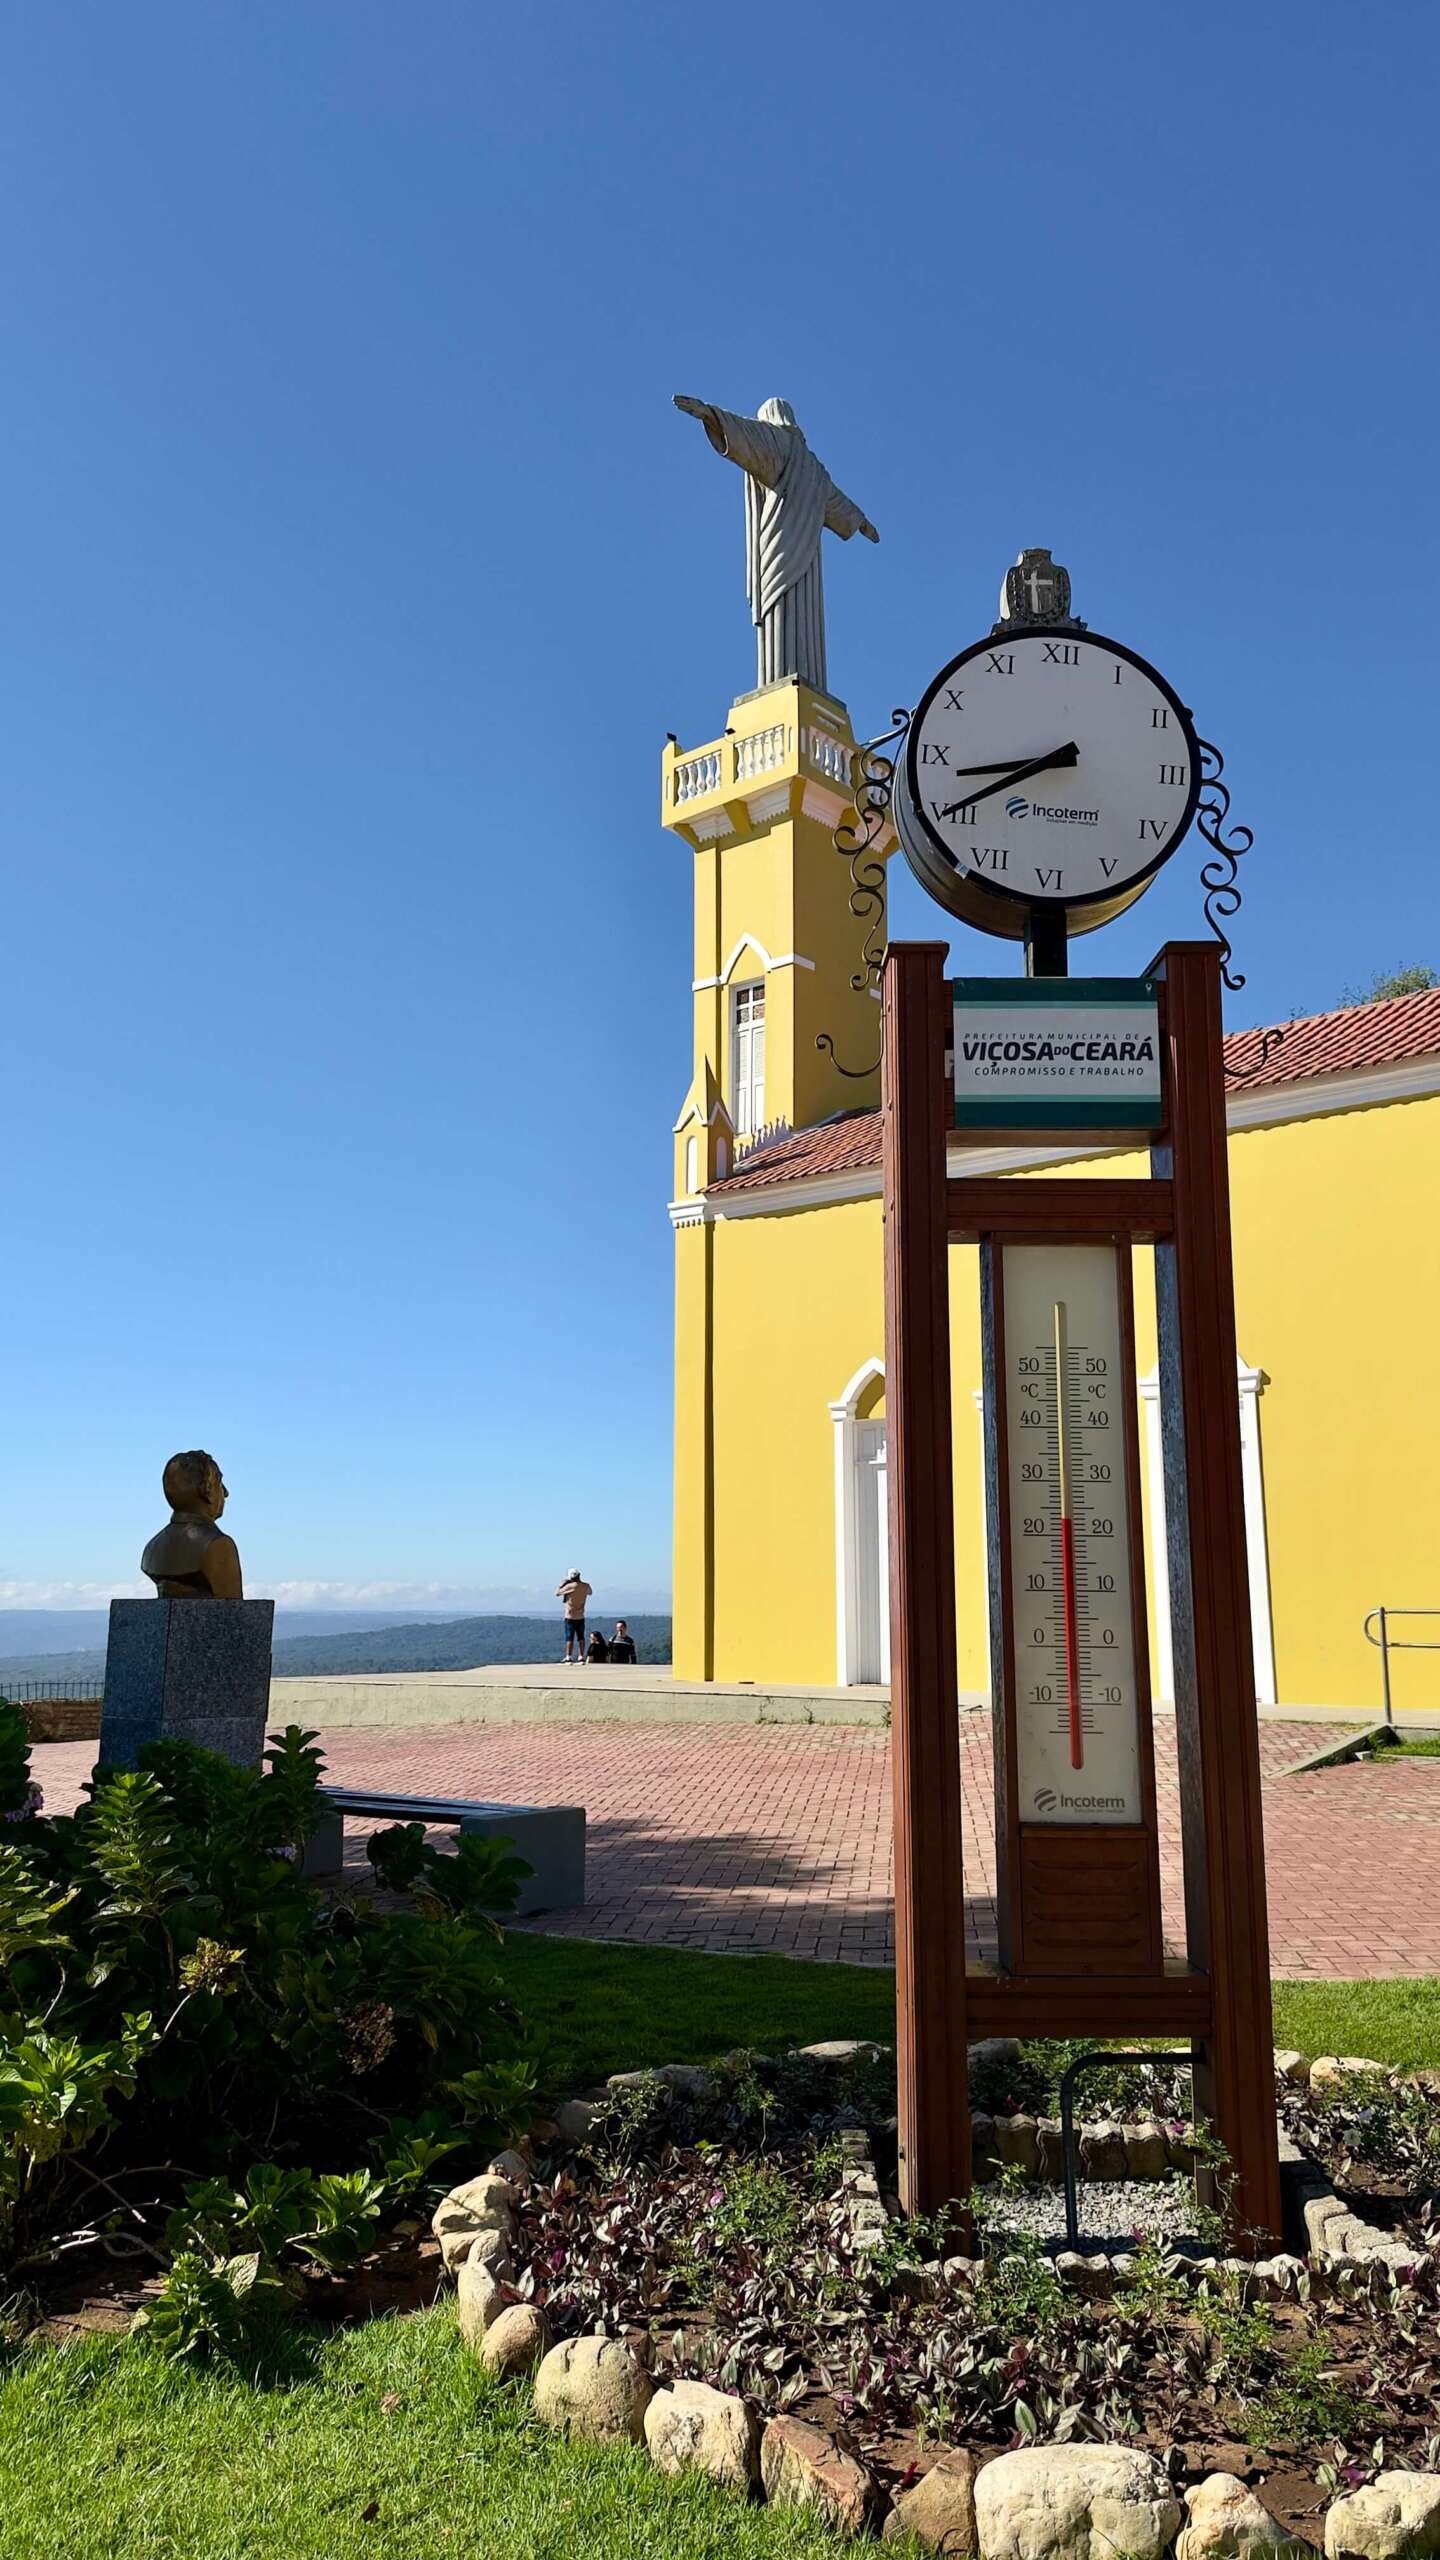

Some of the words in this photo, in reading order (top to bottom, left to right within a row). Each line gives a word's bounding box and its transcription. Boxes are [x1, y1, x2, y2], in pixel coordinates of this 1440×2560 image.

[1041, 643, 1081, 666] XII
[985, 653, 1016, 674] XI
[1113, 665, 1122, 685] I
[944, 689, 965, 711] X
[1151, 708, 1169, 729] II
[921, 744, 951, 766] IX
[1159, 764, 1186, 786] III
[929, 801, 978, 825] VIII
[1032, 803, 1099, 821] Incoterm
[1138, 819, 1169, 841] IV
[970, 847, 1009, 870] VII
[1098, 857, 1119, 878] V
[1034, 868, 1064, 890] VI
[964, 1032, 1043, 1041] PREFEITURA
[1047, 1032, 1118, 1041] MUNICIPAL
[1125, 1032, 1140, 1041] DE
[962, 1041, 1055, 1068] VIÇOSA
[1070, 1036, 1154, 1061] CEARÁ
[974, 1066, 1066, 1076] COMPROMISSO
[1069, 1066, 1076, 1076] E
[1080, 1066, 1145, 1076] TRABALHO
[1018, 1357, 1040, 1372] 50
[1085, 1358, 1107, 1373] 50
[1020, 1410, 1041, 1425] 40
[1087, 1411, 1109, 1426] 40
[1022, 1463, 1043, 1479] 30
[1089, 1464, 1111, 1480] 30
[1023, 1518, 1045, 1533] 20
[1092, 1519, 1113, 1534] 20
[1027, 1574, 1045, 1589] 10
[1098, 1575, 1114, 1590] 10
[1033, 1628, 1045, 1644] 0
[1102, 1629, 1114, 1644] 0
[1028, 1685, 1052, 1701] -10
[1098, 1686, 1122, 1702] -10
[1060, 1793, 1126, 1808] Incoterm
